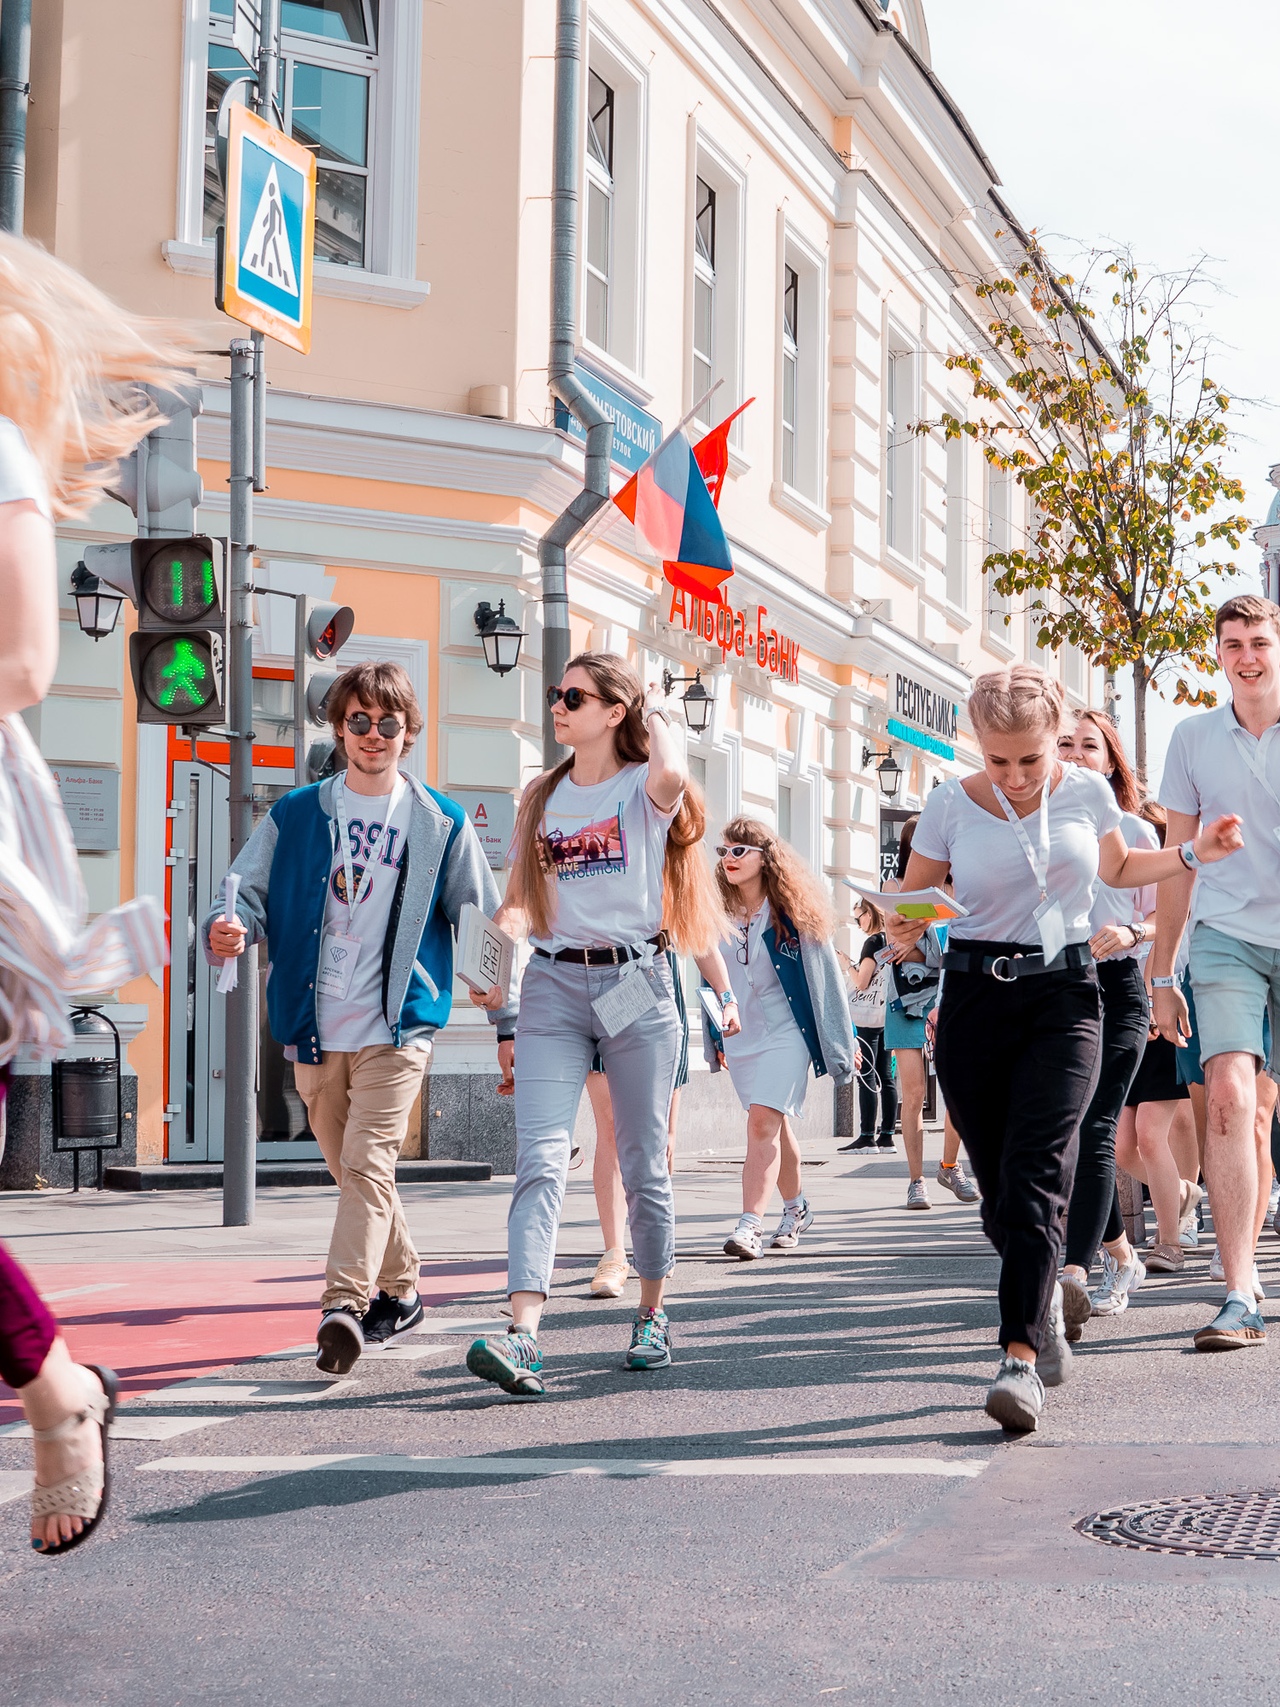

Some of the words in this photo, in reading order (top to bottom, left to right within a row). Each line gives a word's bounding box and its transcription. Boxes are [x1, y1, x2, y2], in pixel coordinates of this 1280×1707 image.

[613, 436, 632, 459] ЕУЛОК
[171, 560, 213, 607] 11
[896, 672, 957, 741] РЕСПУБЛИКА
[558, 864, 622, 881] REVOLUTION
